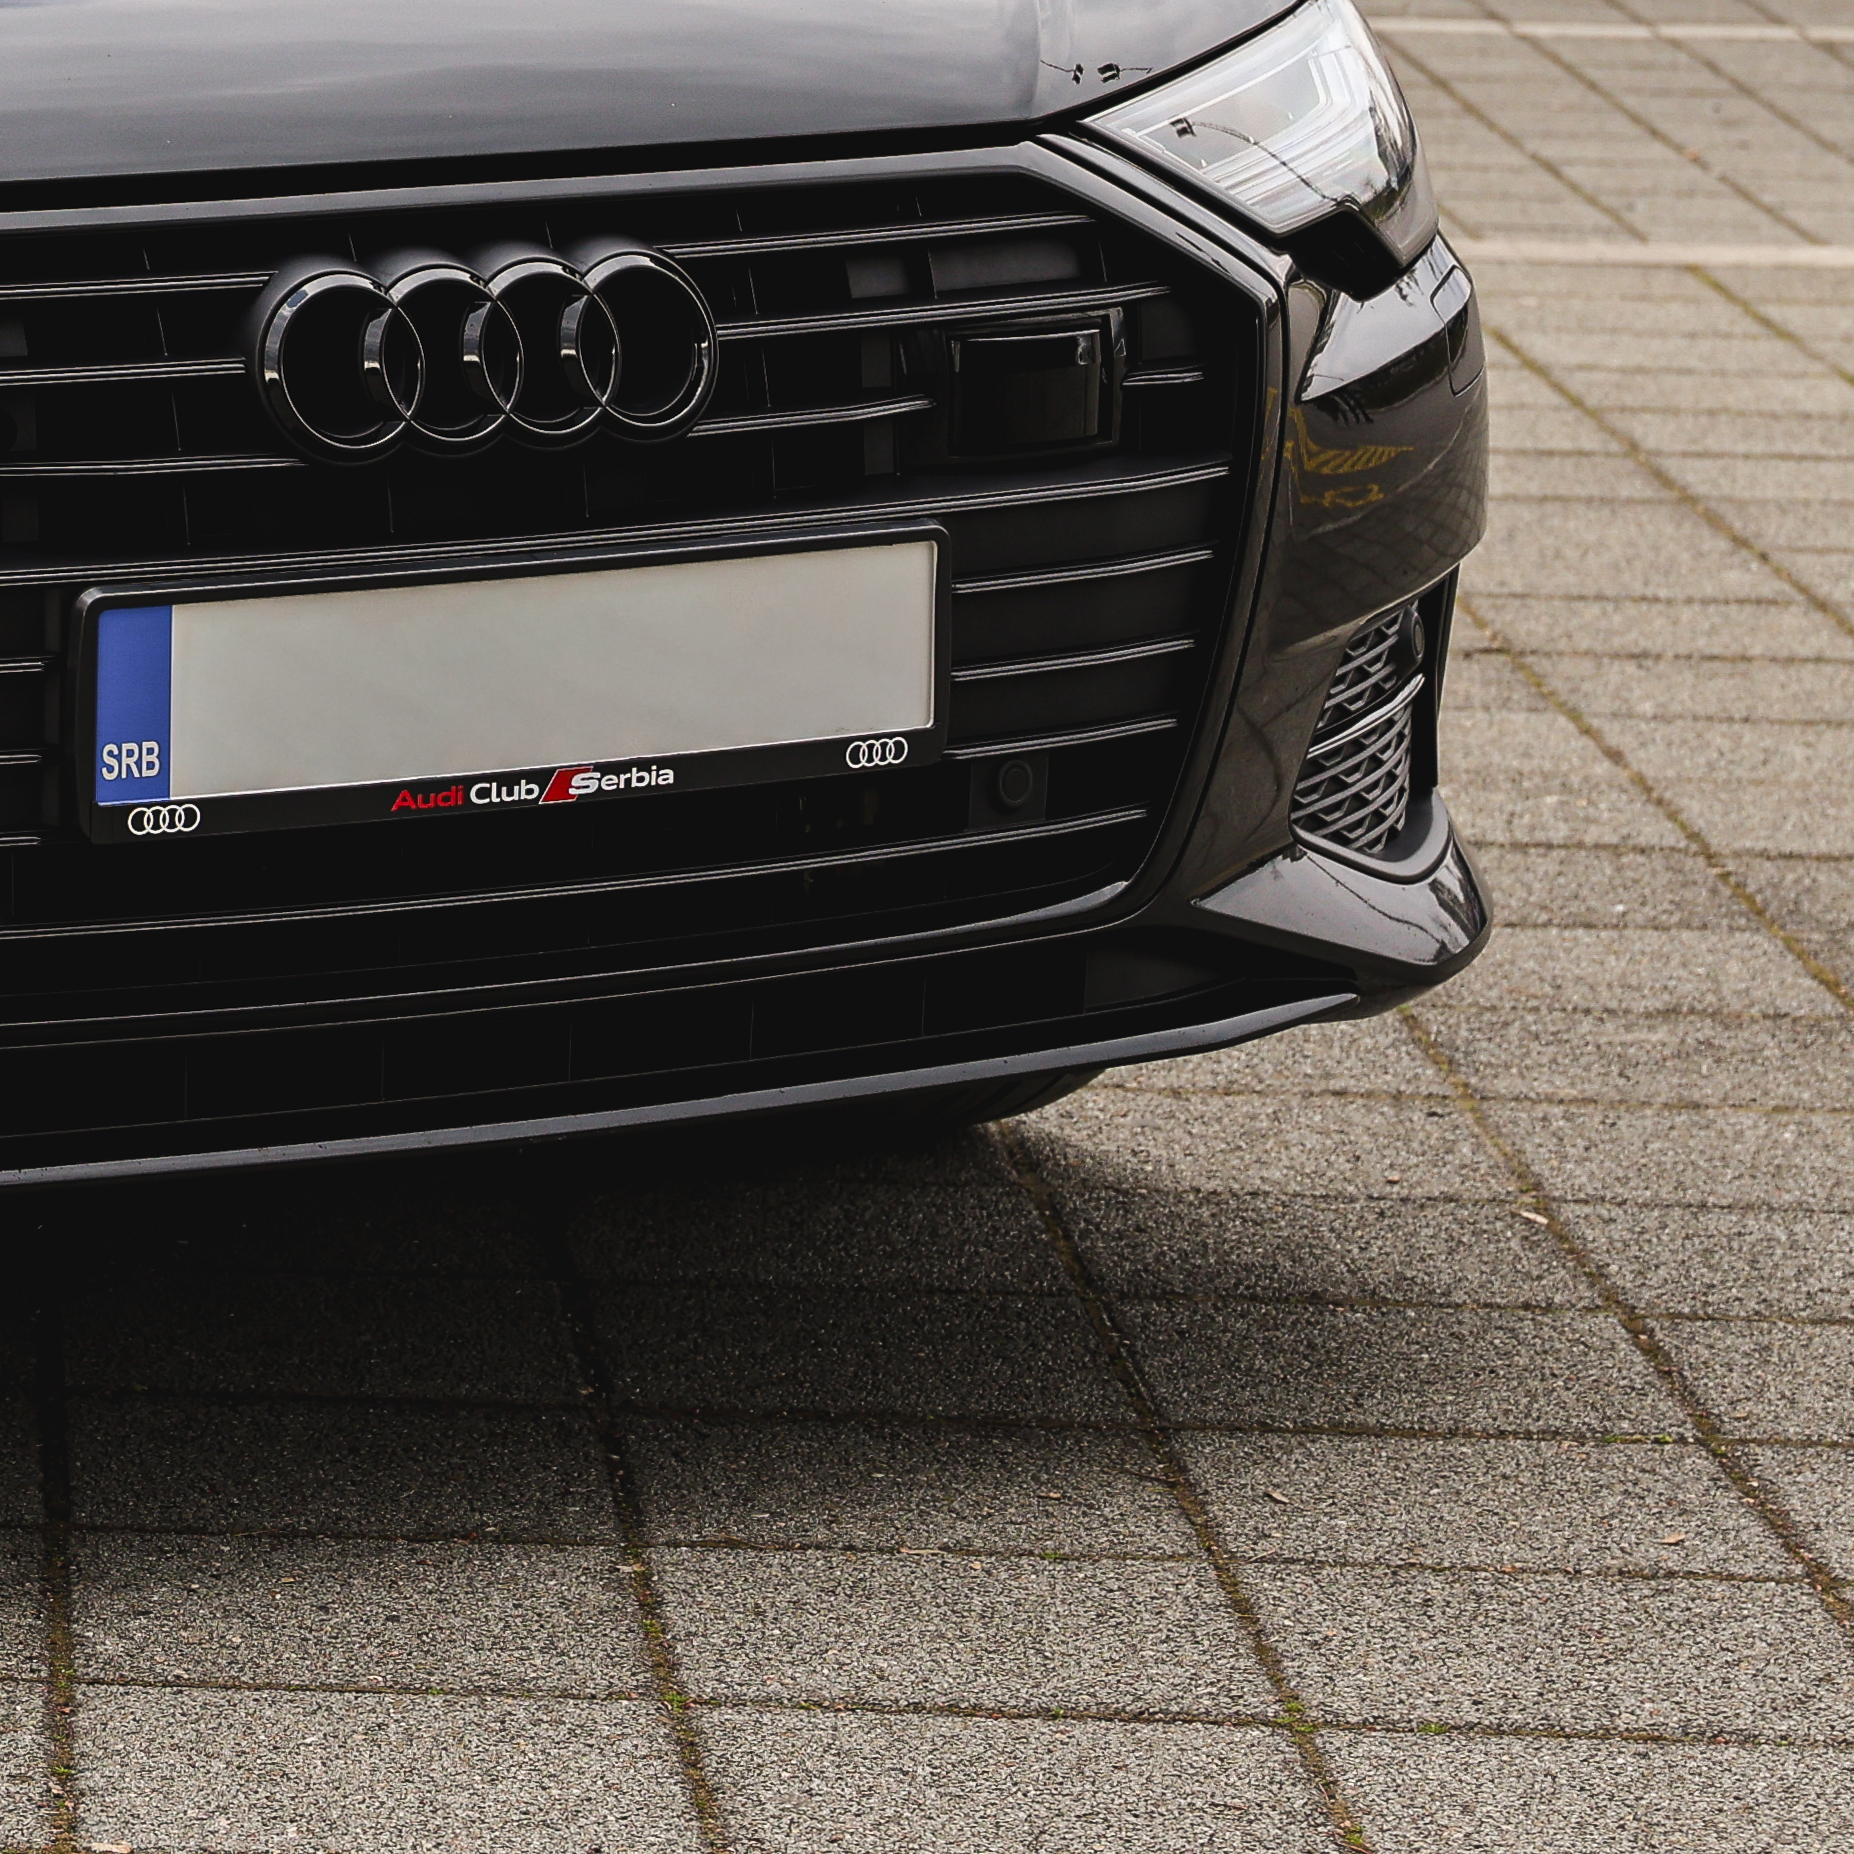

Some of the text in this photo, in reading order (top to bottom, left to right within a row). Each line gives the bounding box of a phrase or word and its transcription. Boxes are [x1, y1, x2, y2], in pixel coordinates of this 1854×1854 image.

[101, 740, 160, 781] SRB
[391, 765, 675, 812] Audi Club Serbia
